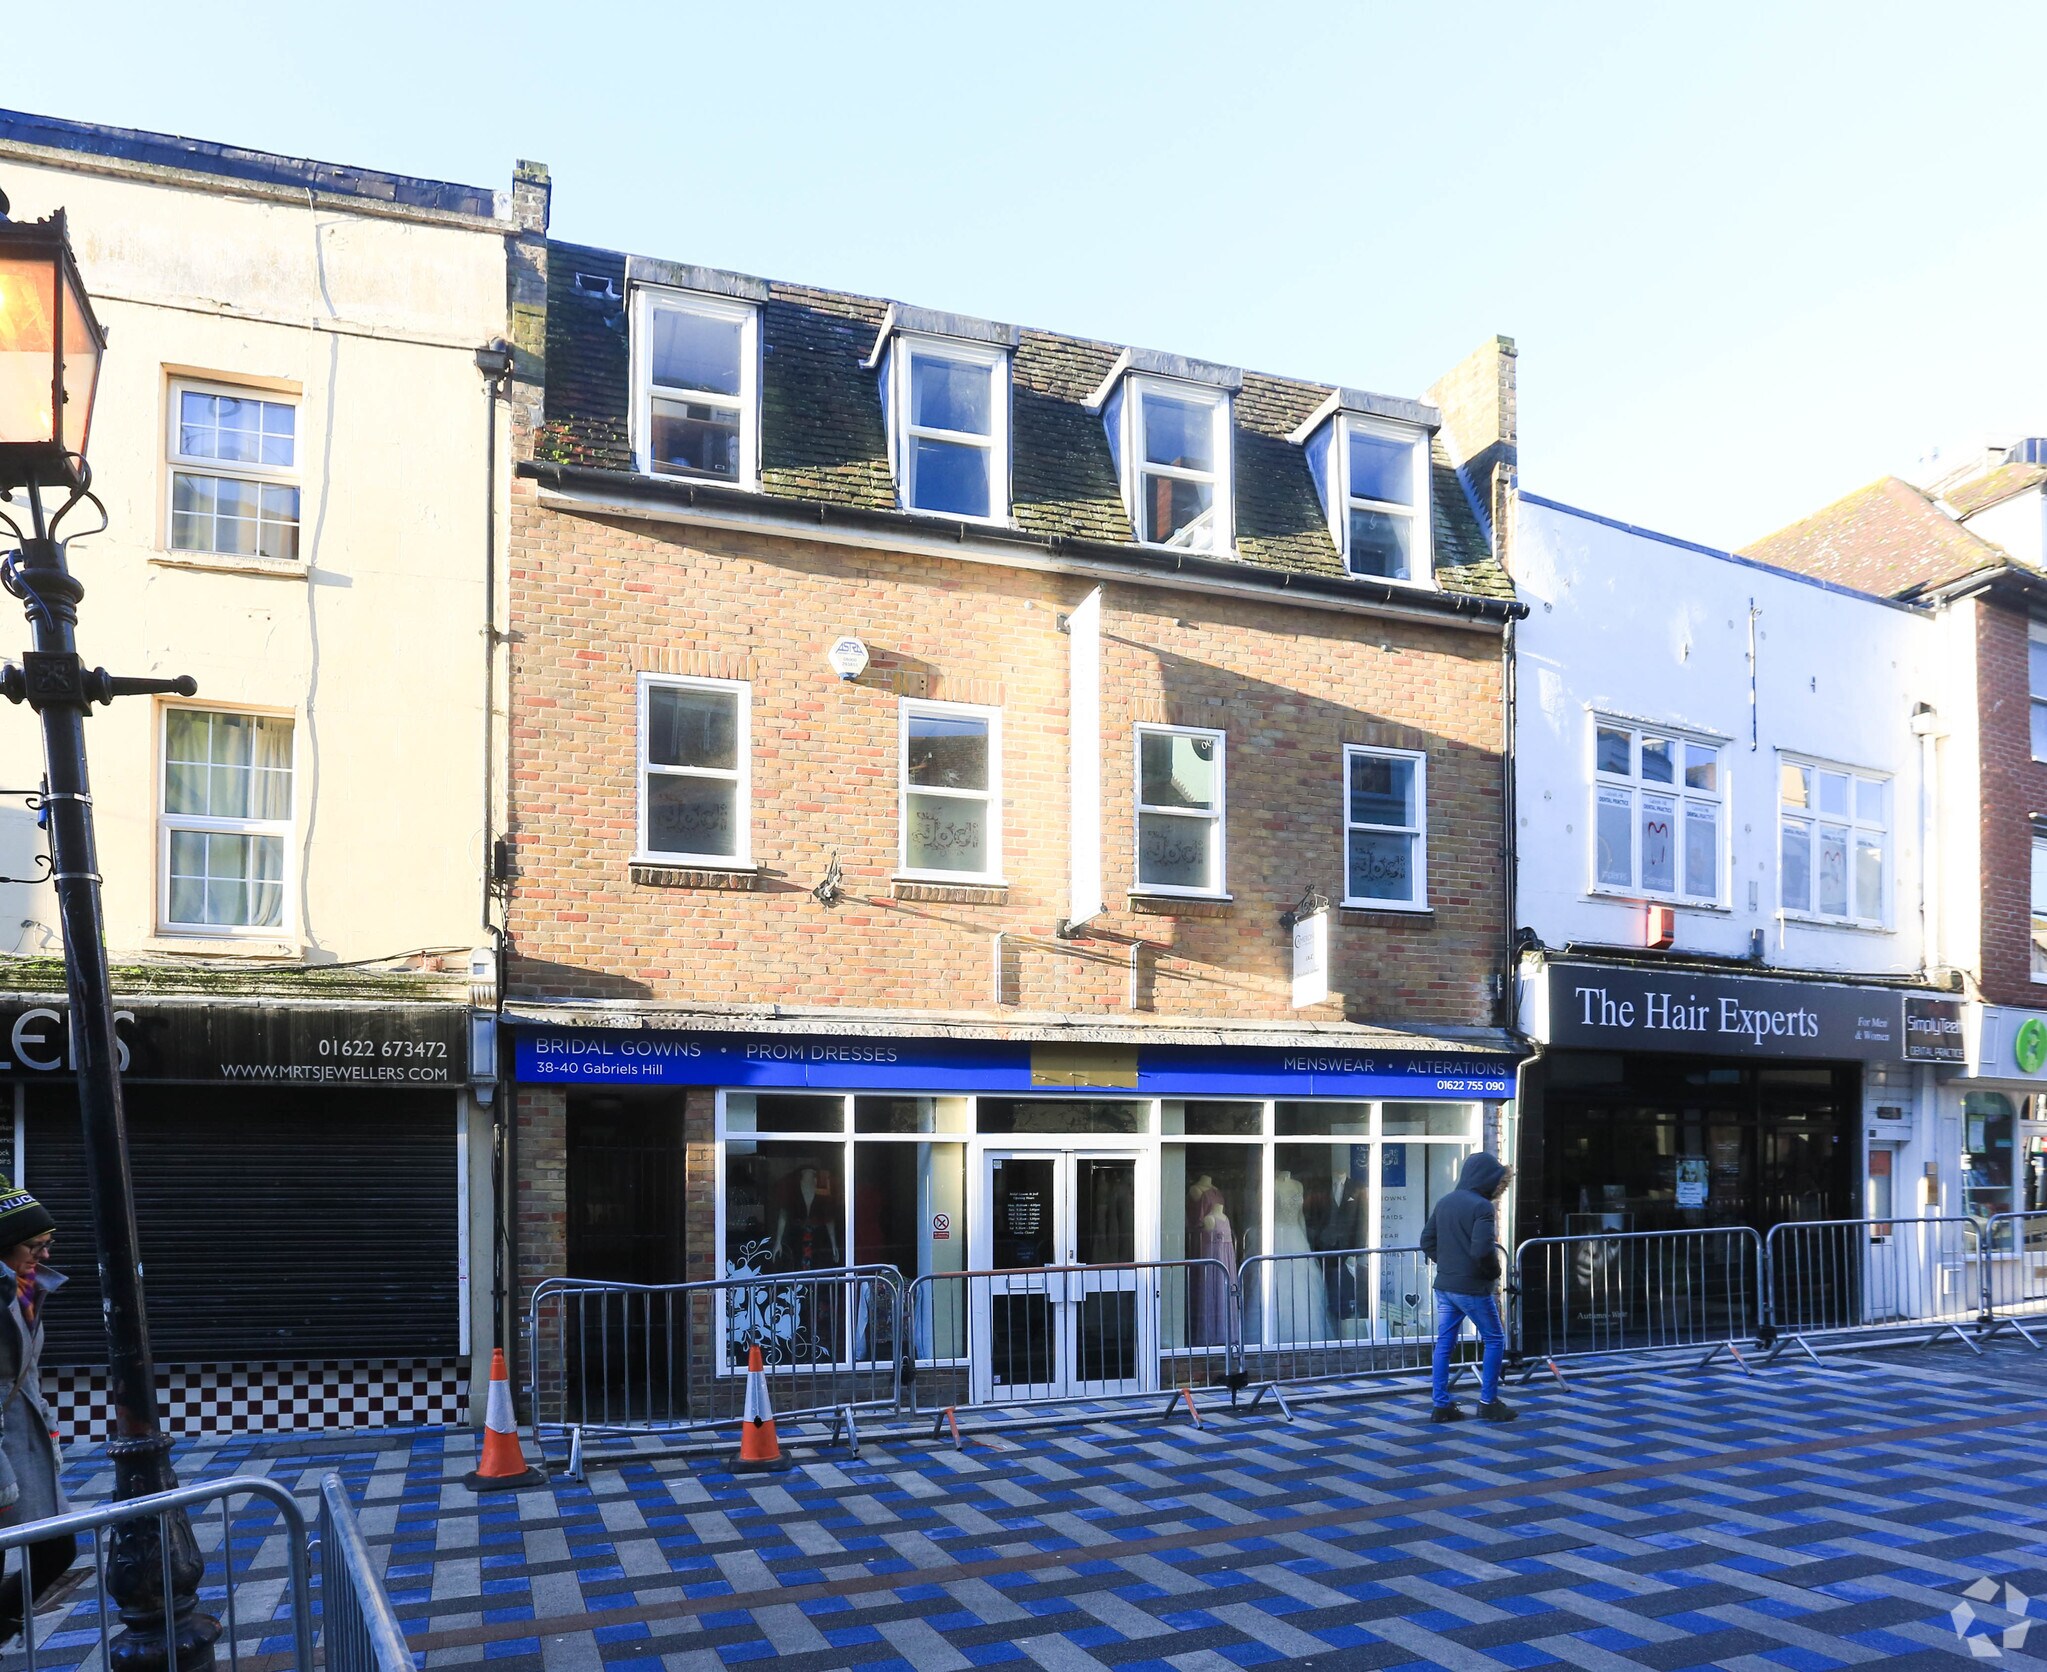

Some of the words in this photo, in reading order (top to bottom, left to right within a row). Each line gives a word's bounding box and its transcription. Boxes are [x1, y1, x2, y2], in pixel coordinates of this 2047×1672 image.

[835, 641, 865, 656] ASTRA
[1575, 987, 1635, 1028] The
[1643, 992, 1710, 1032] Hair
[1718, 997, 1819, 1045] Experts
[1857, 1017, 1870, 1027] For
[1871, 1017, 1888, 1028] Men
[1863, 1030, 1890, 1041] Women
[319, 1039, 375, 1057] 01622
[382, 1040, 448, 1058] 673472
[536, 1038, 614, 1056] BRIDAL
[620, 1040, 701, 1058] GOWNS
[746, 1044, 804, 1060] PROM
[811, 1045, 897, 1062] DRESSES
[536, 1061, 579, 1074] 38-40
[583, 1062, 638, 1076] Gabriels
[642, 1062, 663, 1076] Hill
[1284, 1057, 1375, 1072] MENSWEAR
[1407, 1060, 1505, 1076] ALTERATIONS
[1436, 1079, 1464, 1091] 01622
[1466, 1080, 1483, 1091] 755
[1485, 1081, 1505, 1091] 090
